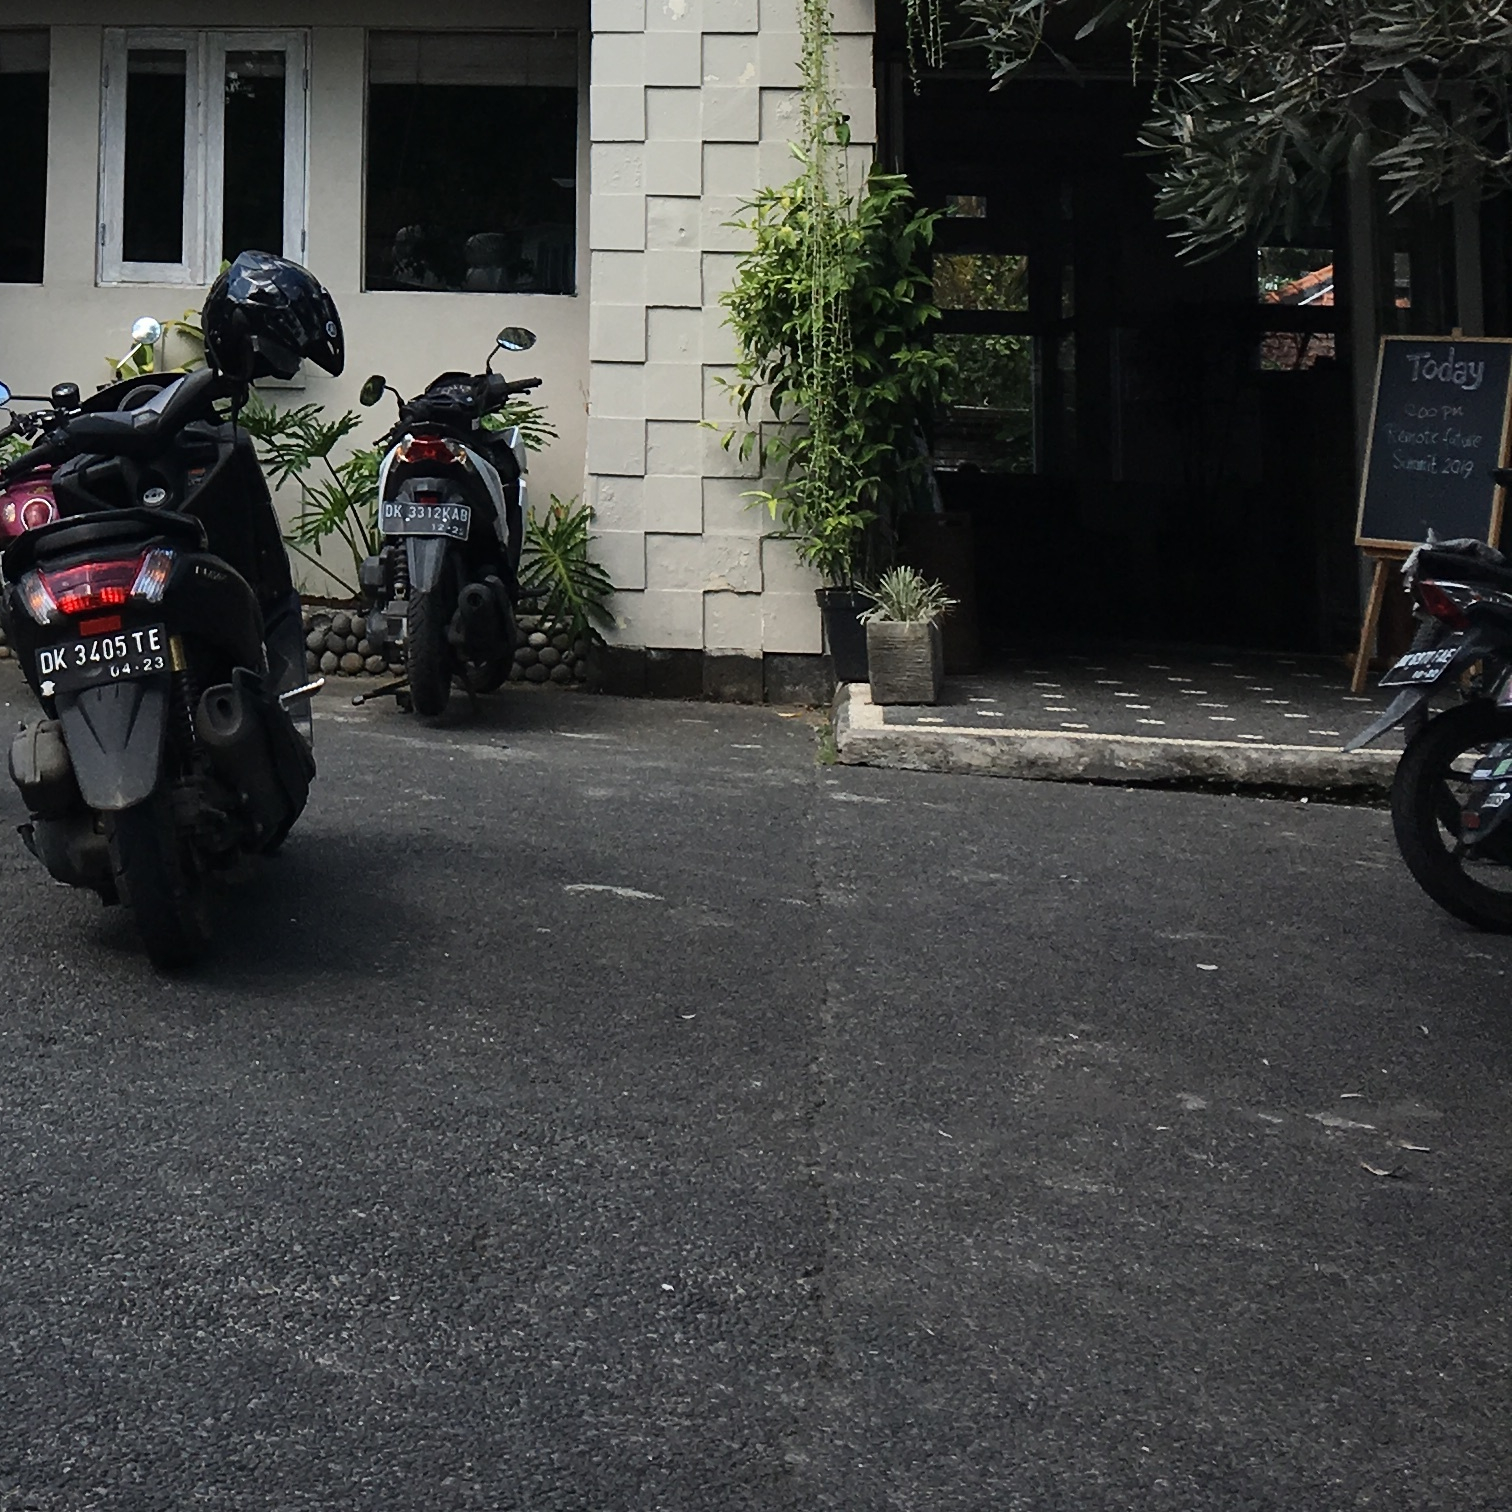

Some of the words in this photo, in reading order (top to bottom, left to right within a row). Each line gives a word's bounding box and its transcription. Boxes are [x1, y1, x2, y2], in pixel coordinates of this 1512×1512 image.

[1405, 346, 1485, 391] Today
[1441, 457, 1475, 480] 2019
[384, 504, 403, 518] DK
[40, 647, 68, 675] DK
[73, 635, 128, 666] 3405
